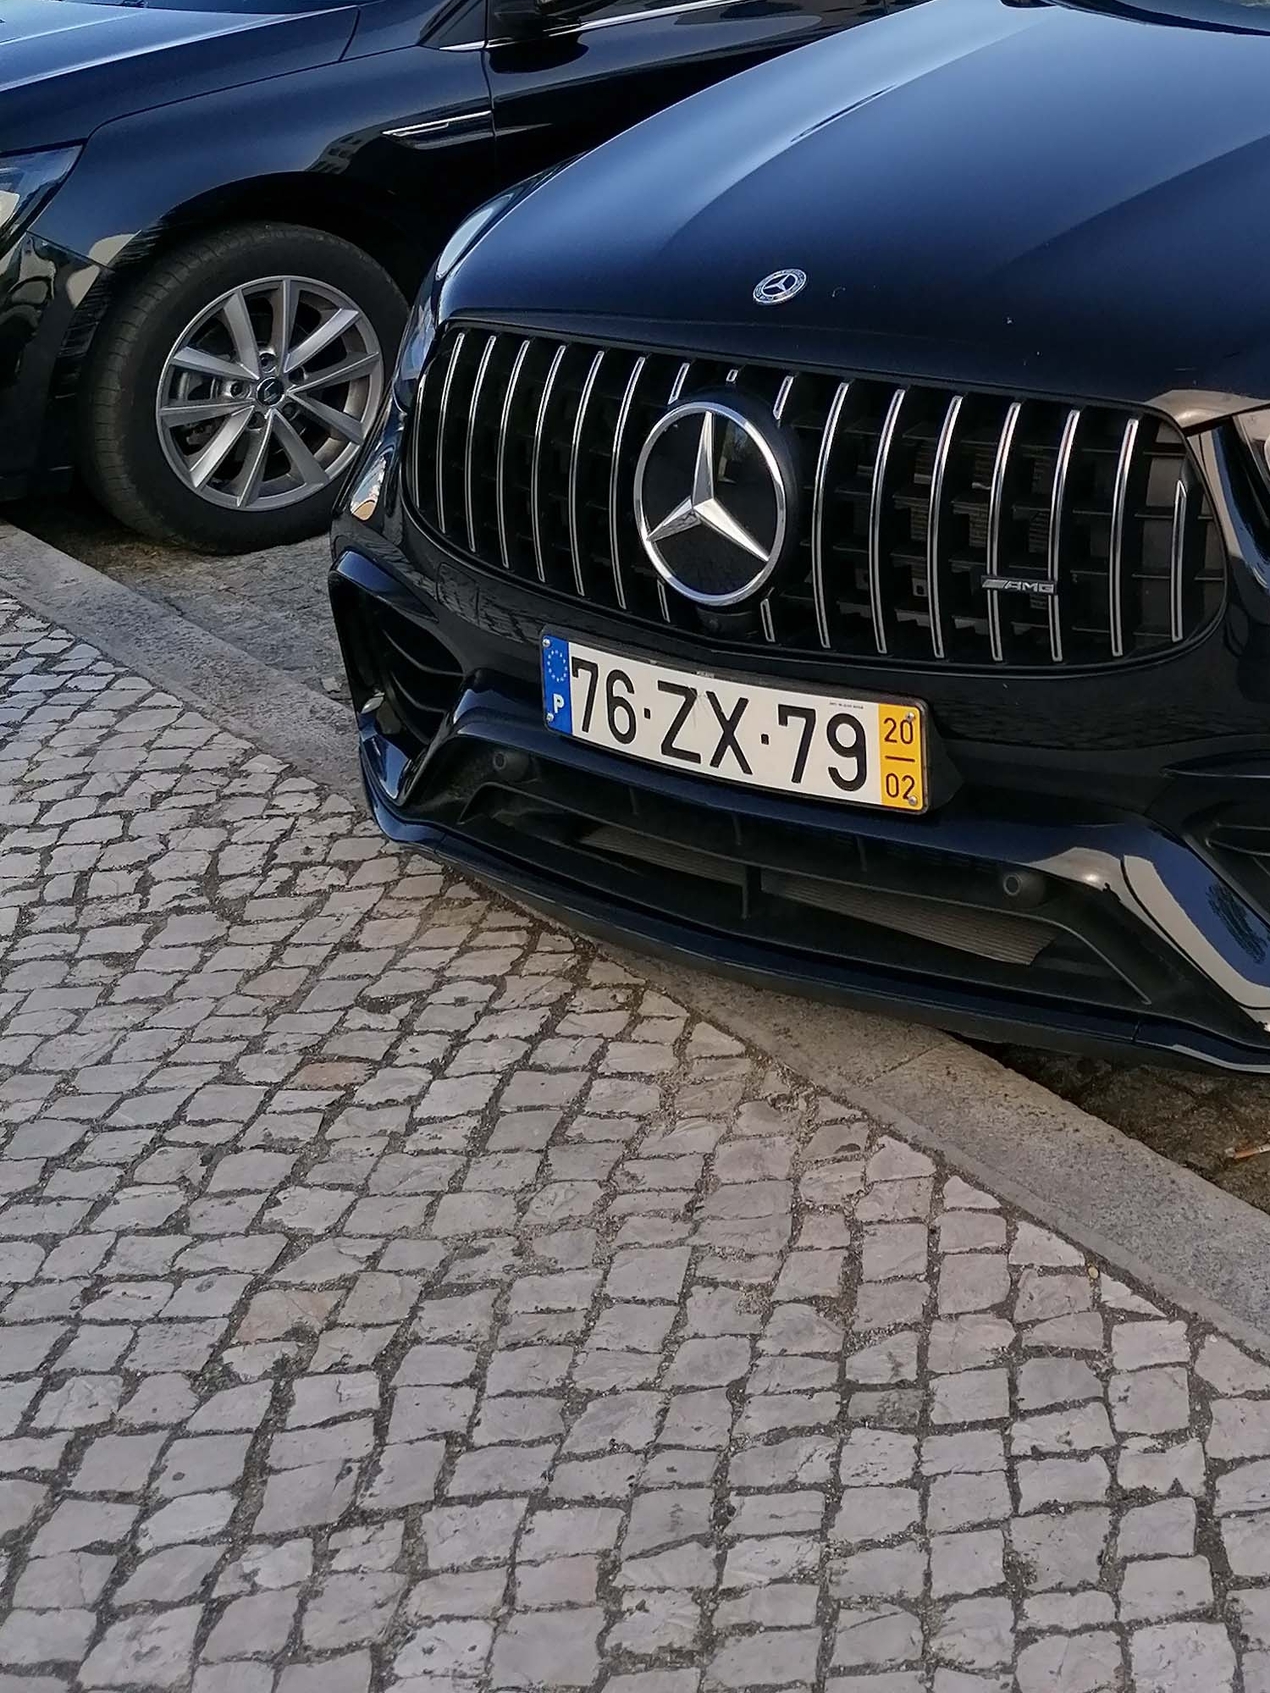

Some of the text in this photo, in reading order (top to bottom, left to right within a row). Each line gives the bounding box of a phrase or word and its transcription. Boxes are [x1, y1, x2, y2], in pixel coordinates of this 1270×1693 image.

[1004, 581, 1054, 594] AMG
[553, 693, 565, 714] P
[883, 717, 914, 745] 20
[885, 772, 916, 800] 02
